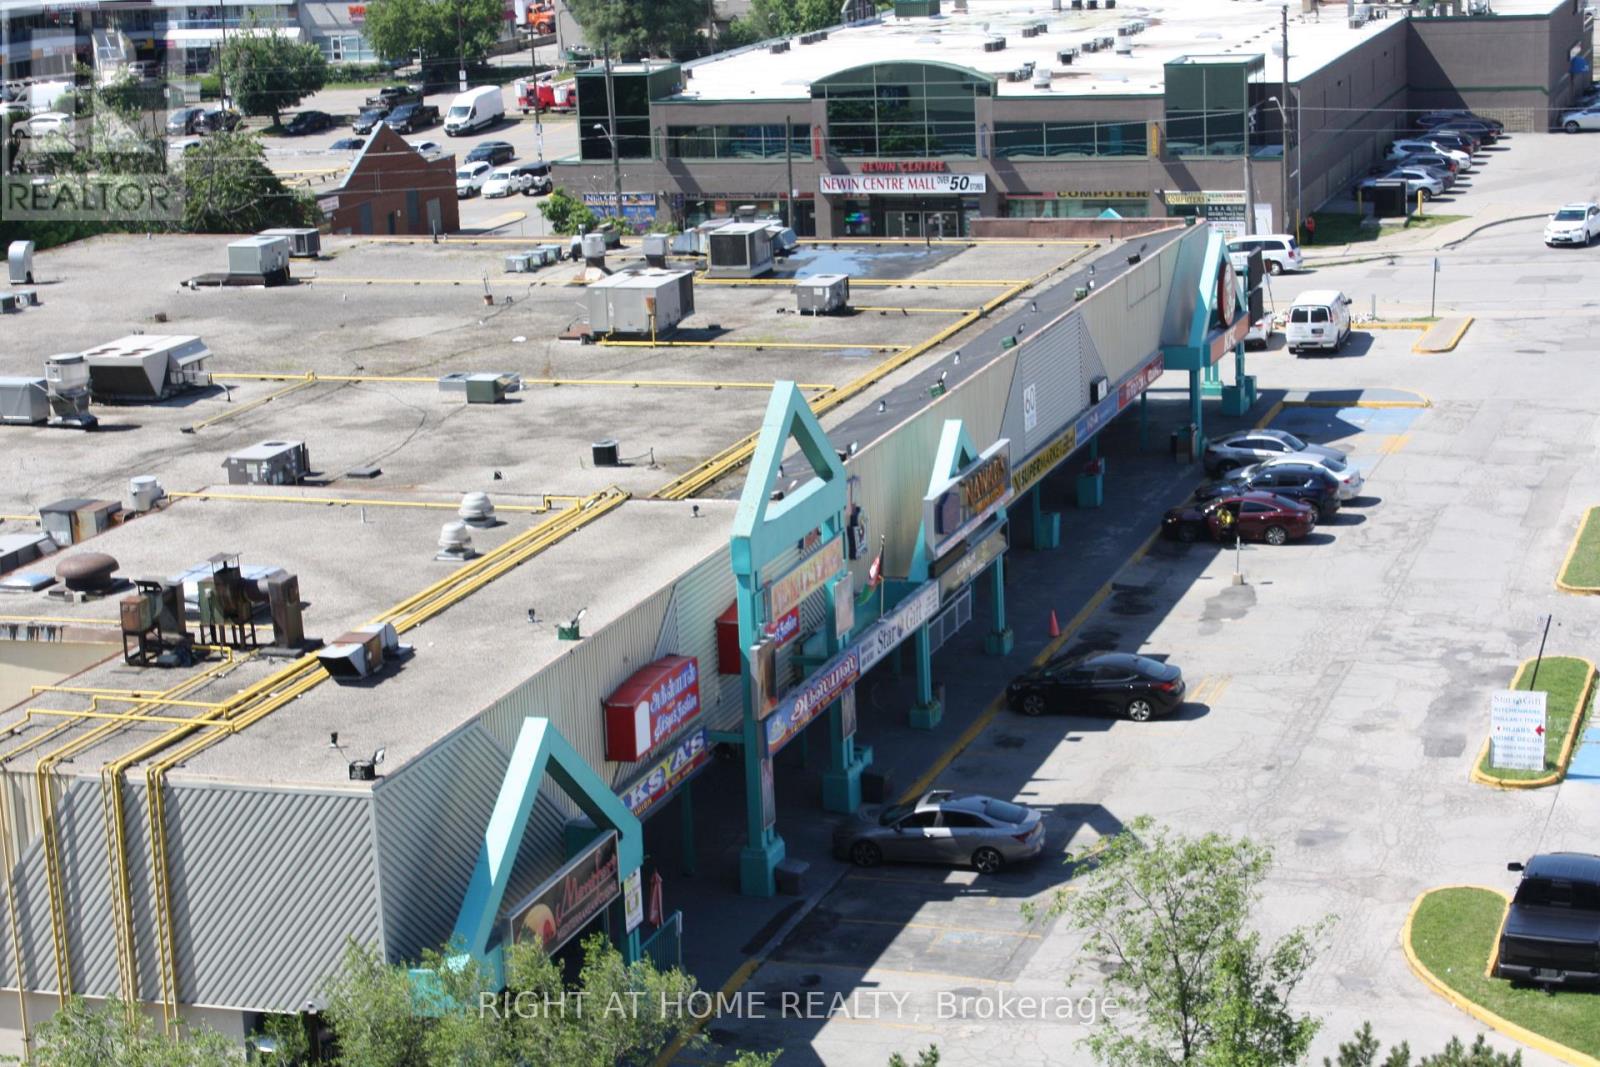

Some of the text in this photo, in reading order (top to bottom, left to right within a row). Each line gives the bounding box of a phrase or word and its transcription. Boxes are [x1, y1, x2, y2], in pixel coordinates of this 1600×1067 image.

[823, 176, 859, 190] NEWIN
[864, 176, 904, 191] CENTRE
[907, 176, 936, 190] MALL
[950, 176, 970, 191] 50
[877, 626, 897, 655] Star
[906, 599, 922, 631] Gift
